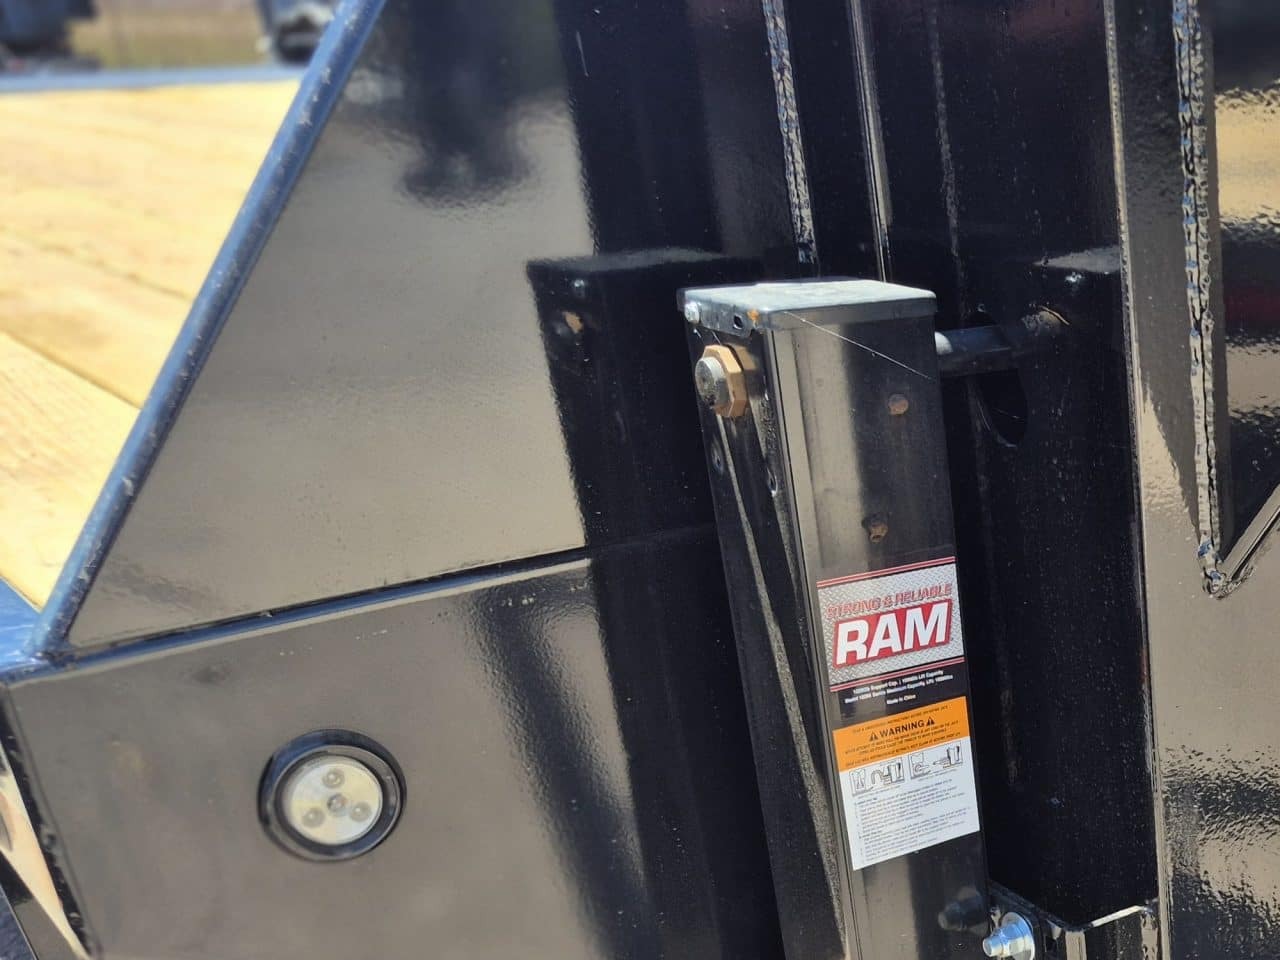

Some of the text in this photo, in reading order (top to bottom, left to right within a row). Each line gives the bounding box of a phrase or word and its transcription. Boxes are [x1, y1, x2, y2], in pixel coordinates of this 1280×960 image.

[826, 597, 881, 619] STRONG
[836, 602, 949, 665] RAM
[880, 719, 925, 738] WARNING
